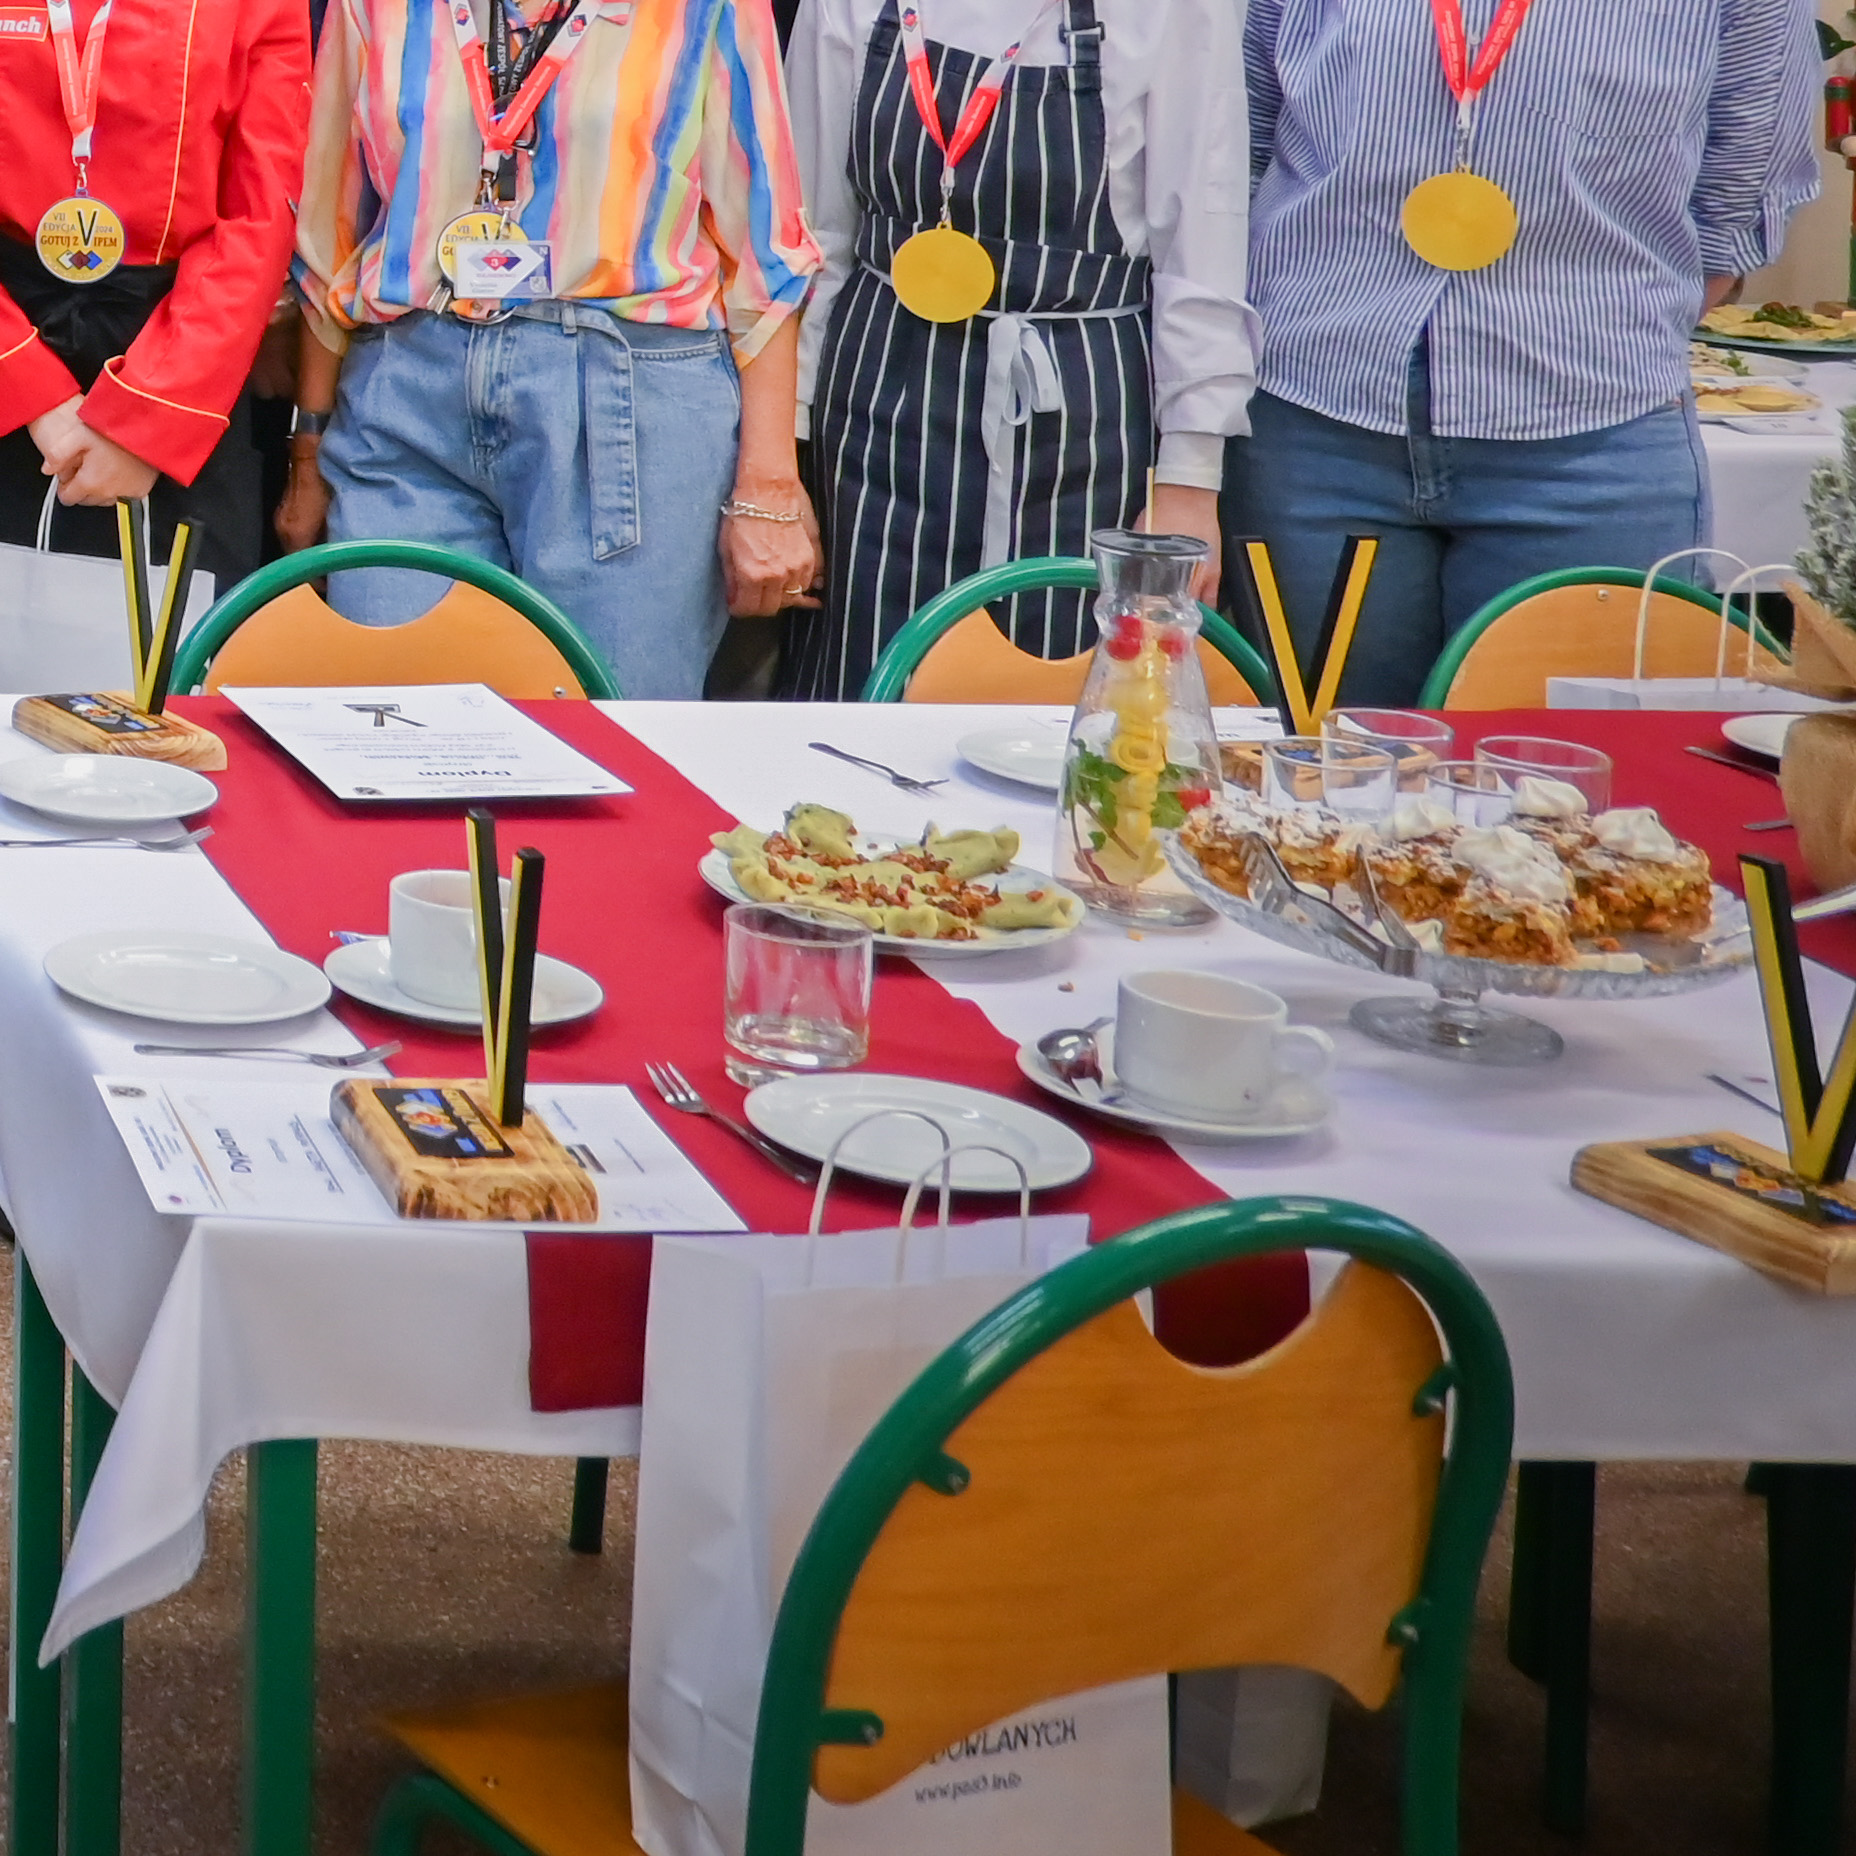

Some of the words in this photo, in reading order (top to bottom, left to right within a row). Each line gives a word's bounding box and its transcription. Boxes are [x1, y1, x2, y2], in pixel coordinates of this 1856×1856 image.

[43, 223, 76, 233] EDYCJA
[40, 235, 70, 248] GOTUJ
[72, 236, 79, 246] Z
[418, 769, 512, 779] Dyplom
[213, 1128, 253, 1174] Dyplom
